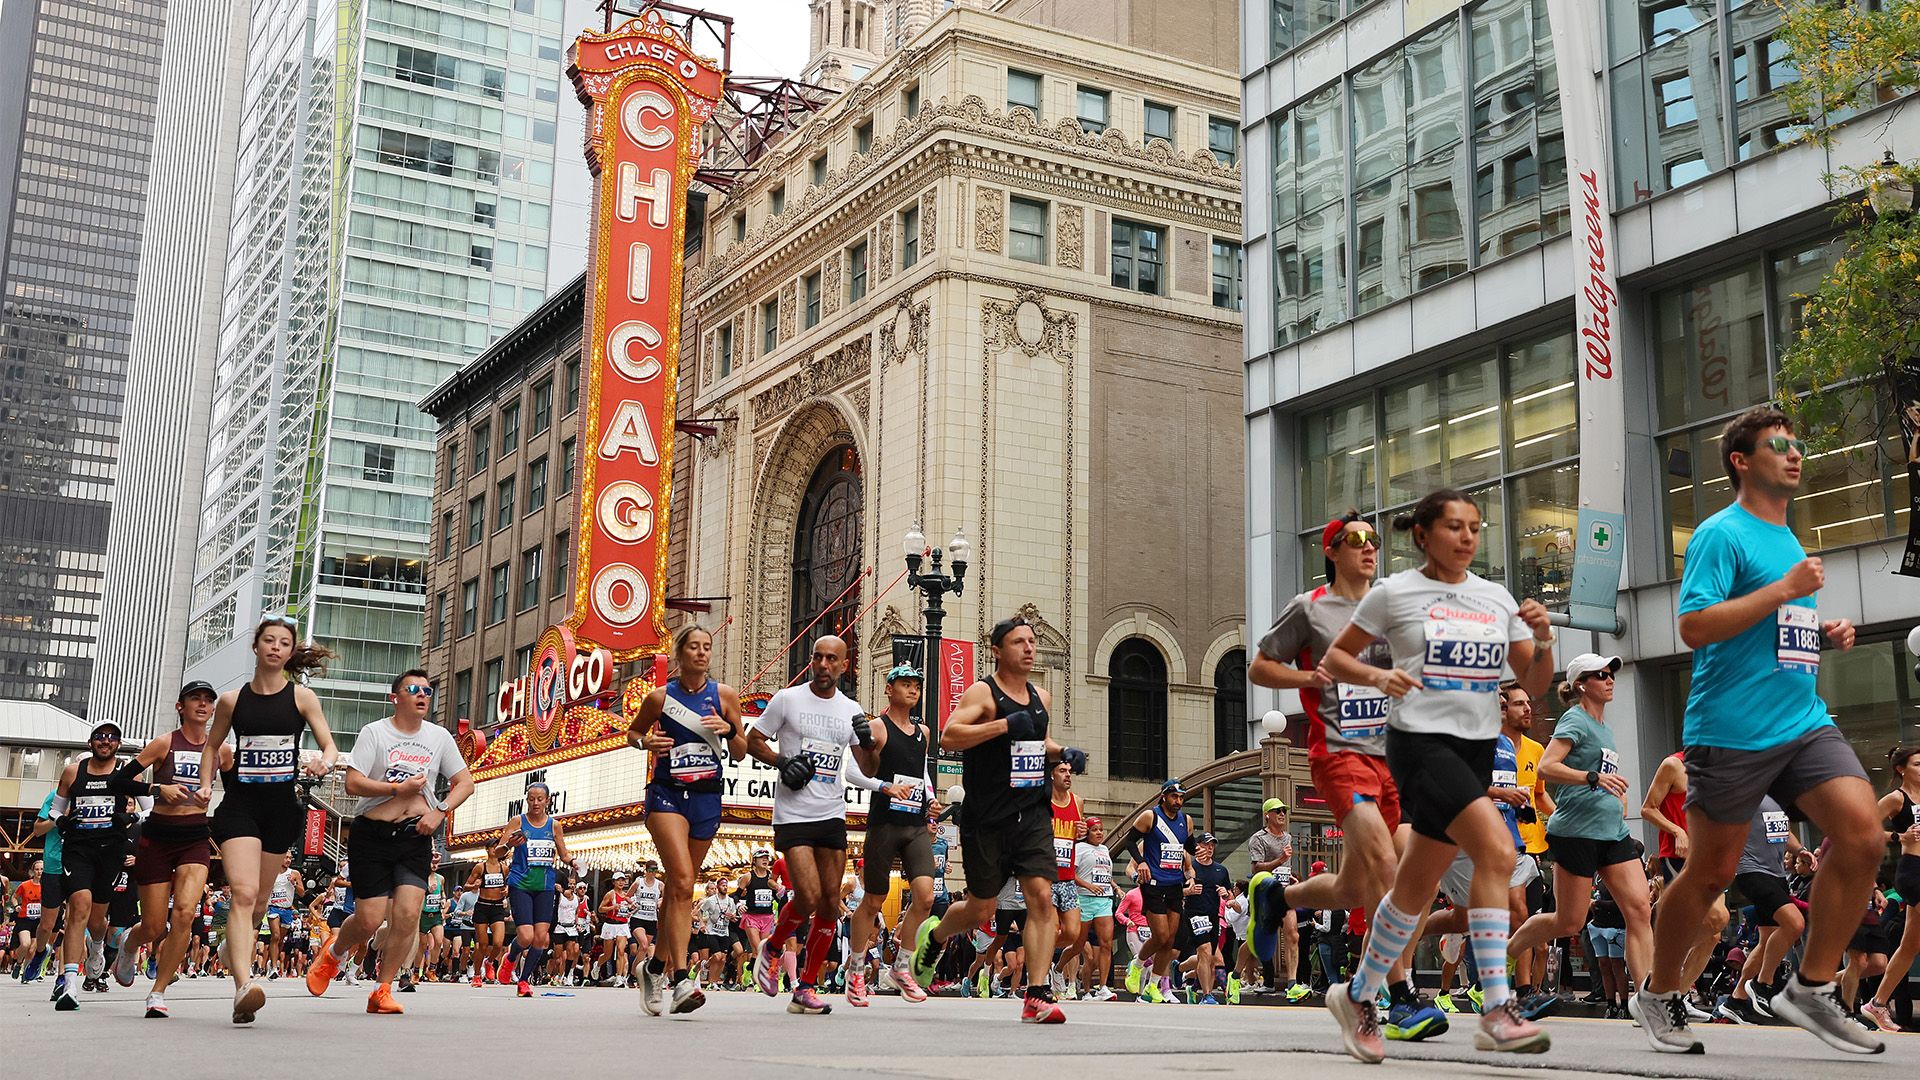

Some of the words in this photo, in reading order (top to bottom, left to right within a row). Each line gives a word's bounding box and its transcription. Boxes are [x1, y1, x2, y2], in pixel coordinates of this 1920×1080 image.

[605, 41, 678, 66] CHASE
[1579, 168, 1618, 381] Walgreens
[590, 90, 675, 628] CHICAGO
[1429, 606, 1497, 624] Chicago
[1779, 627, 1790, 646] E
[1427, 641, 1443, 663] E
[1449, 641, 1504, 667] 4950
[497, 648, 604, 722] CHICAGO
[950, 643, 964, 715] ATONEM
[669, 706, 687, 717] CHI
[1341, 702, 1351, 717] C
[1355, 699, 1389, 717] 1176
[800, 712, 847, 731] PROTECT
[240, 752, 248, 764] E
[253, 751, 293, 765] 15839
[390, 749, 431, 764] Chicago
[671, 759, 680, 767] D
[1012, 756, 1019, 770] E
[175, 765, 182, 774] E
[841, 786, 864, 804] CT
[86, 805, 114, 817] 7134
[310, 811, 321, 853] ATONEMENT
[1766, 822, 1773, 832] E
[1774, 821, 1789, 832] 3961
[528, 848, 534, 856] E
[535, 847, 552, 857] 8951
